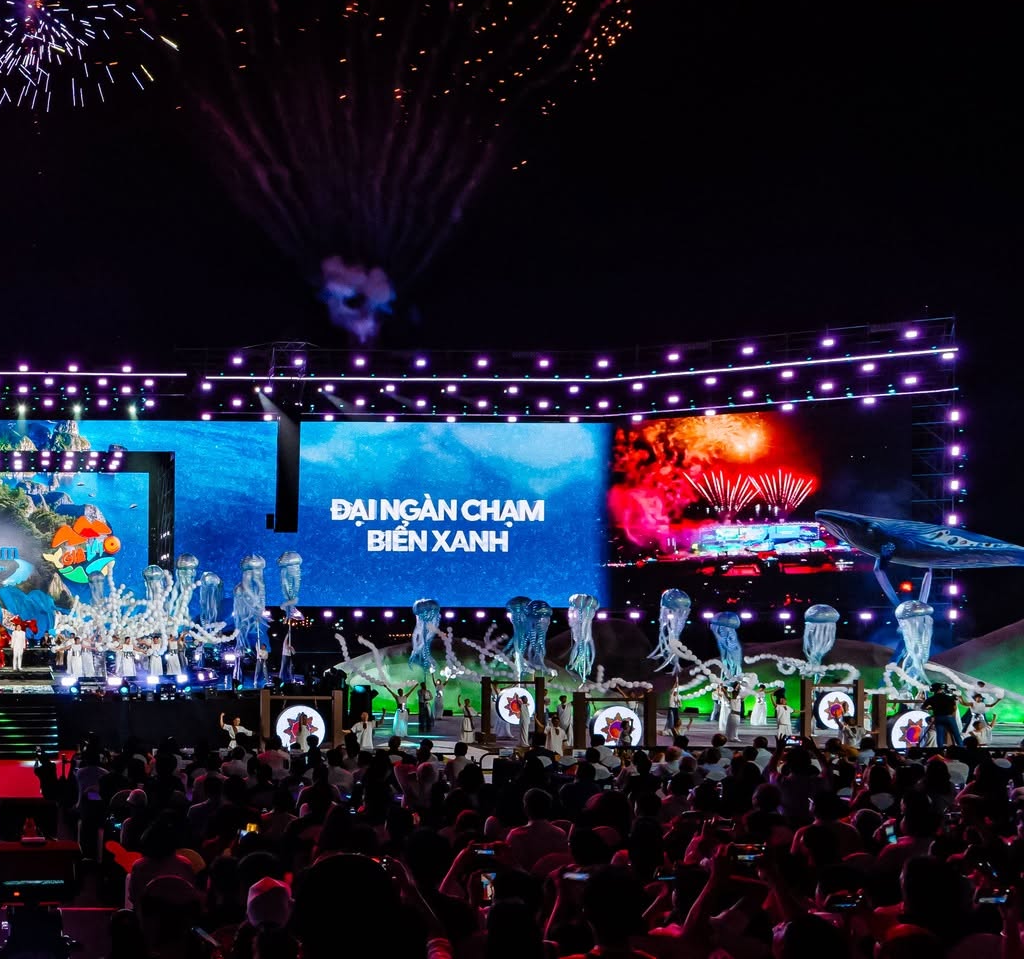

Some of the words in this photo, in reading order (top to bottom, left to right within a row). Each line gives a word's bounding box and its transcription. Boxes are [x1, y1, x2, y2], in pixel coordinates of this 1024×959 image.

[330, 498, 377, 527] ĐẠI
[380, 494, 457, 521] NGÀN
[461, 499, 544, 527] CHẠM
[367, 521, 427, 552] BIỂN
[432, 530, 509, 552] XANH
